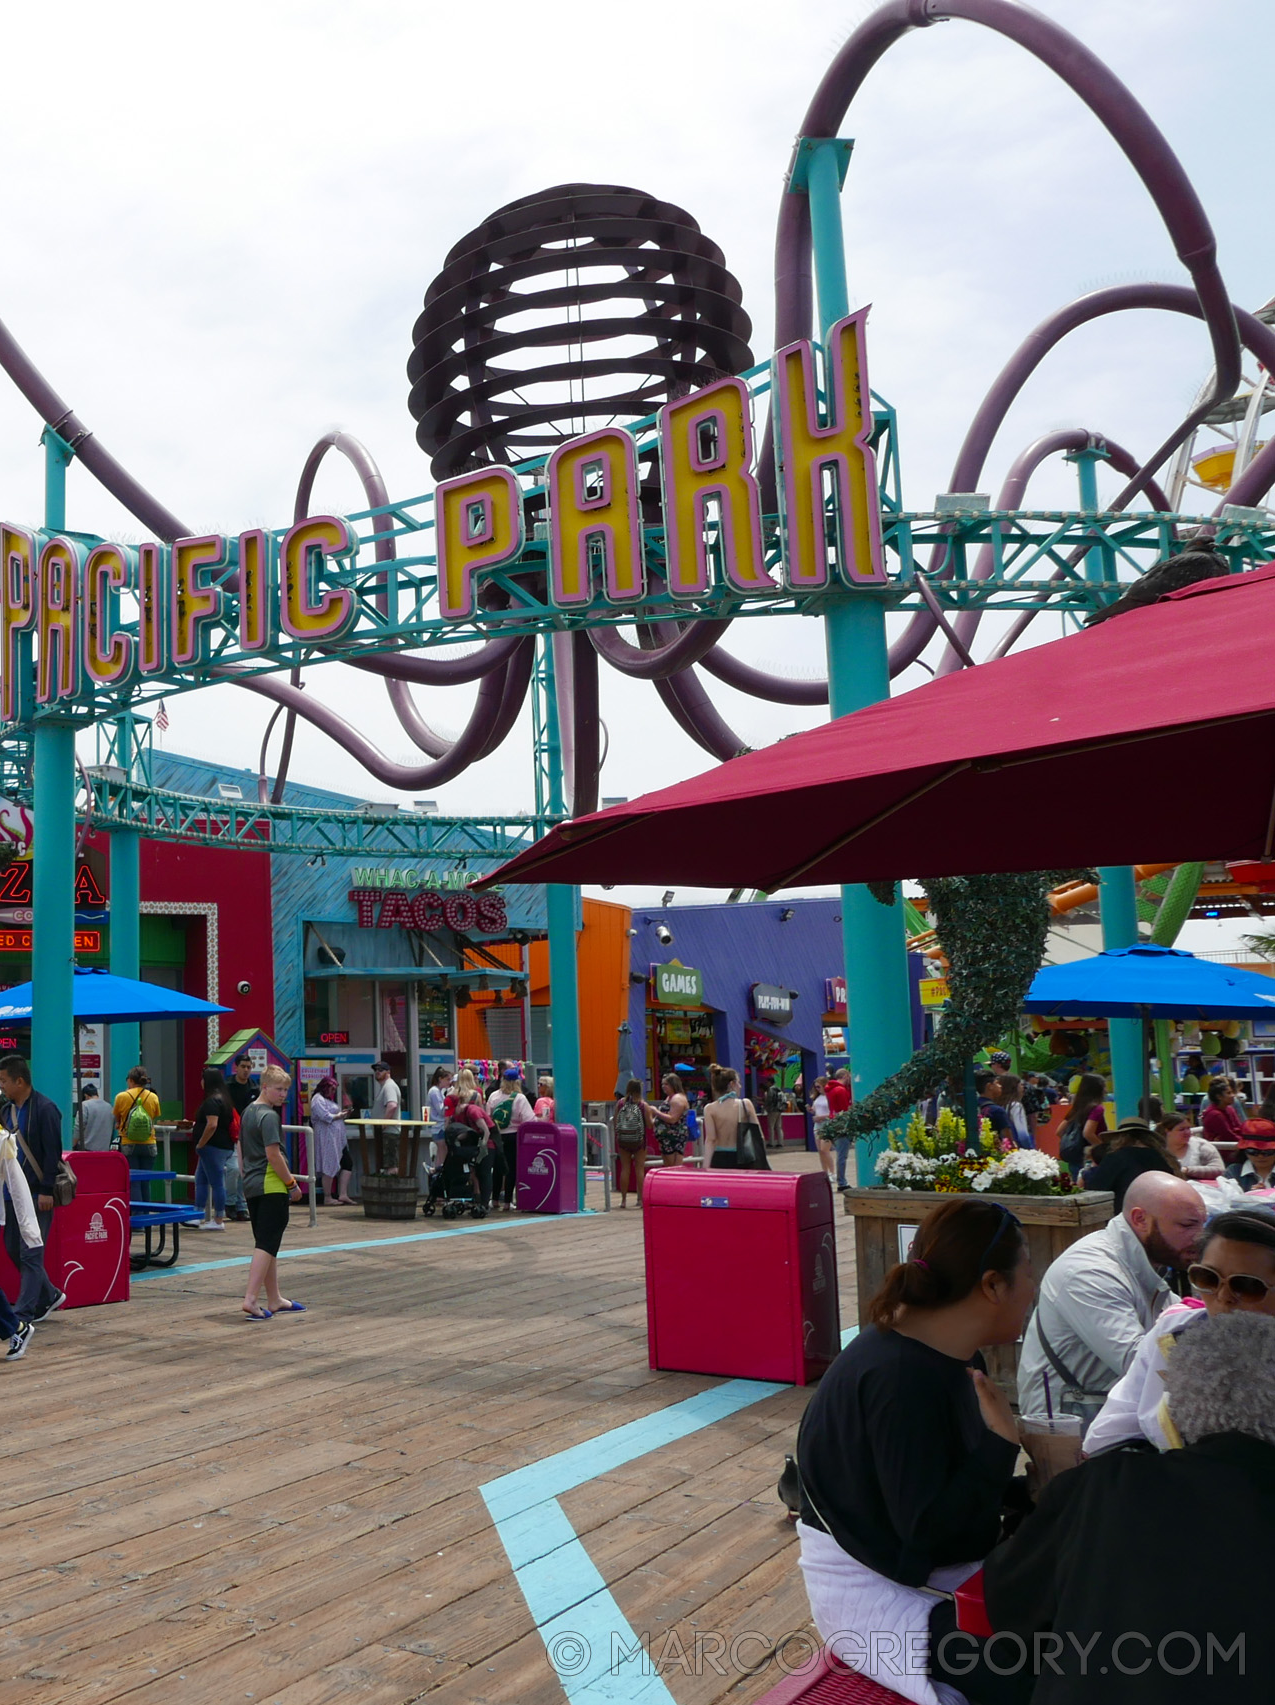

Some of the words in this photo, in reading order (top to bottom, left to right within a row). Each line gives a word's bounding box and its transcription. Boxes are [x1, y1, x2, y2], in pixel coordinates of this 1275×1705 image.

[0, 513, 360, 723] PACIFIC
[434, 303, 889, 621] PARK
[348, 889, 508, 935] TACOS
[661, 973, 697, 995] GAMES
[320, 1033, 347, 1043] OPEN
